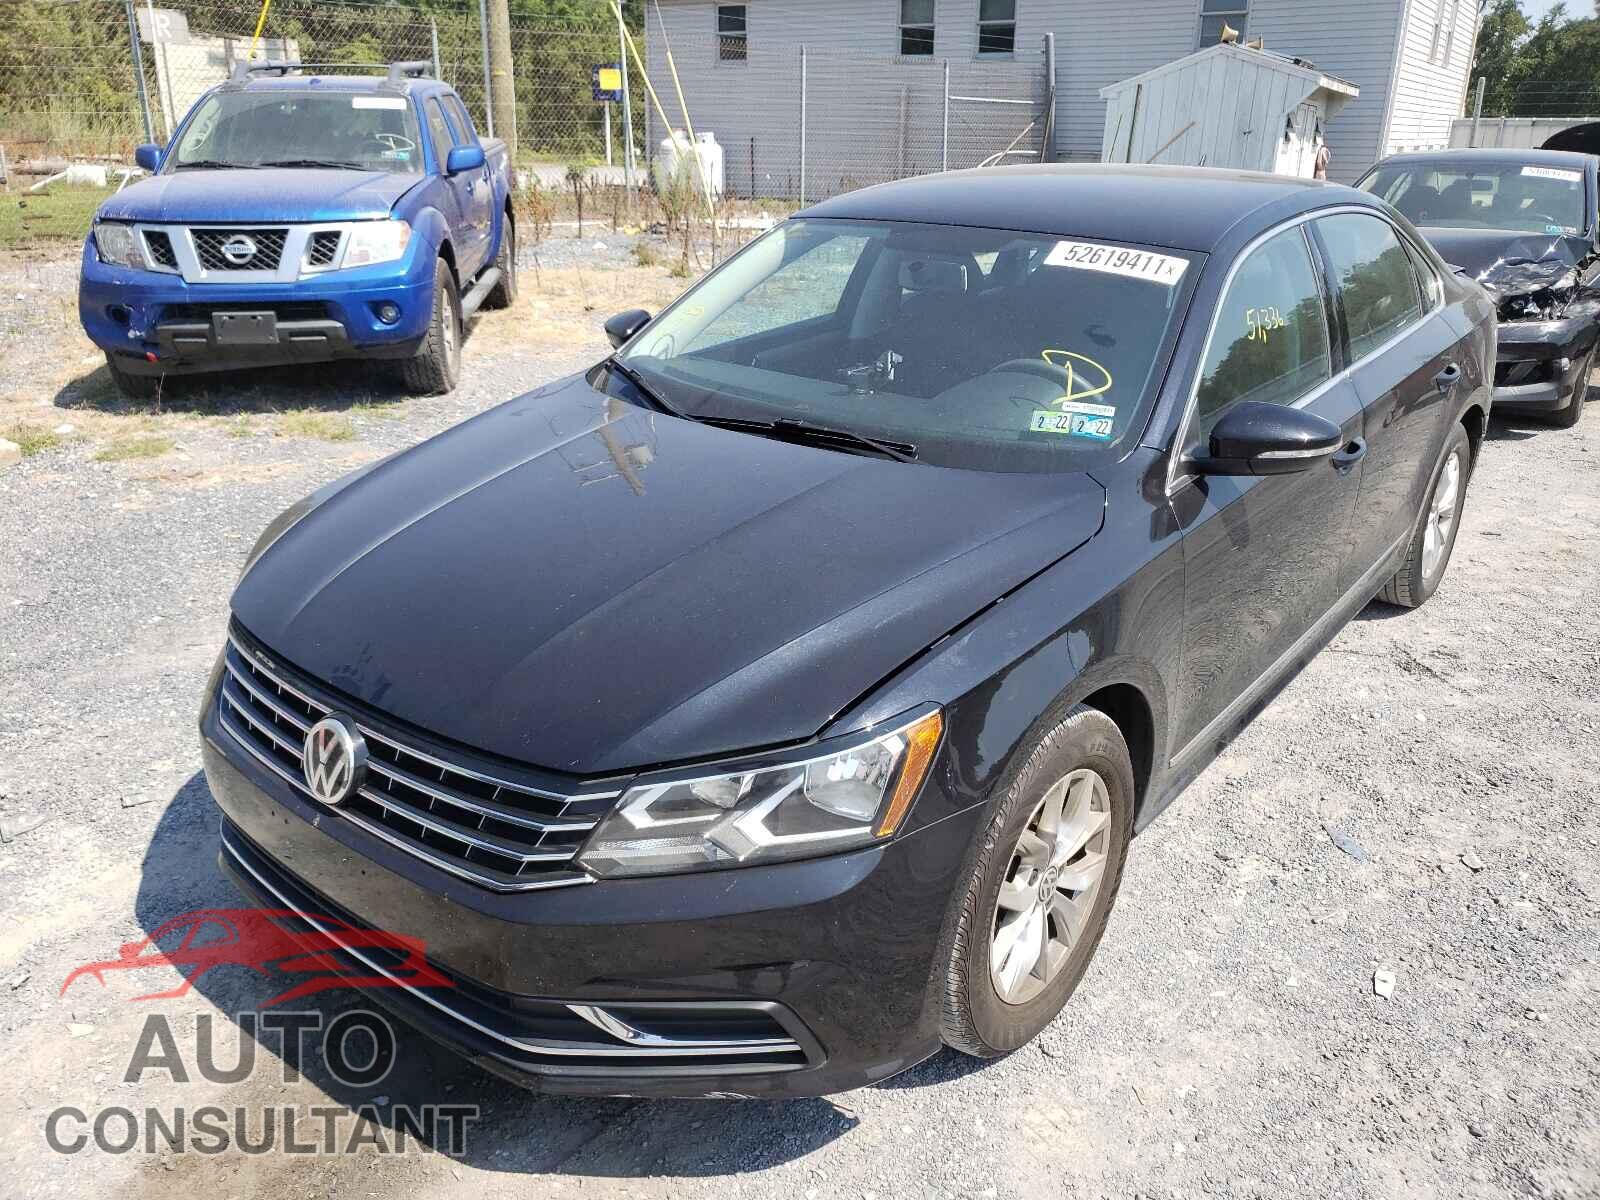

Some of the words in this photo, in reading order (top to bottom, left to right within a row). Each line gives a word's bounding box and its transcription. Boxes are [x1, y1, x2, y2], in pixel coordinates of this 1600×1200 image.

[1064, 245, 1166, 275] 52619411
[1038, 415, 1045, 429] 2
[1055, 415, 1068, 430] 22
[1078, 420, 1085, 433] 2
[1096, 420, 1109, 435] 22
